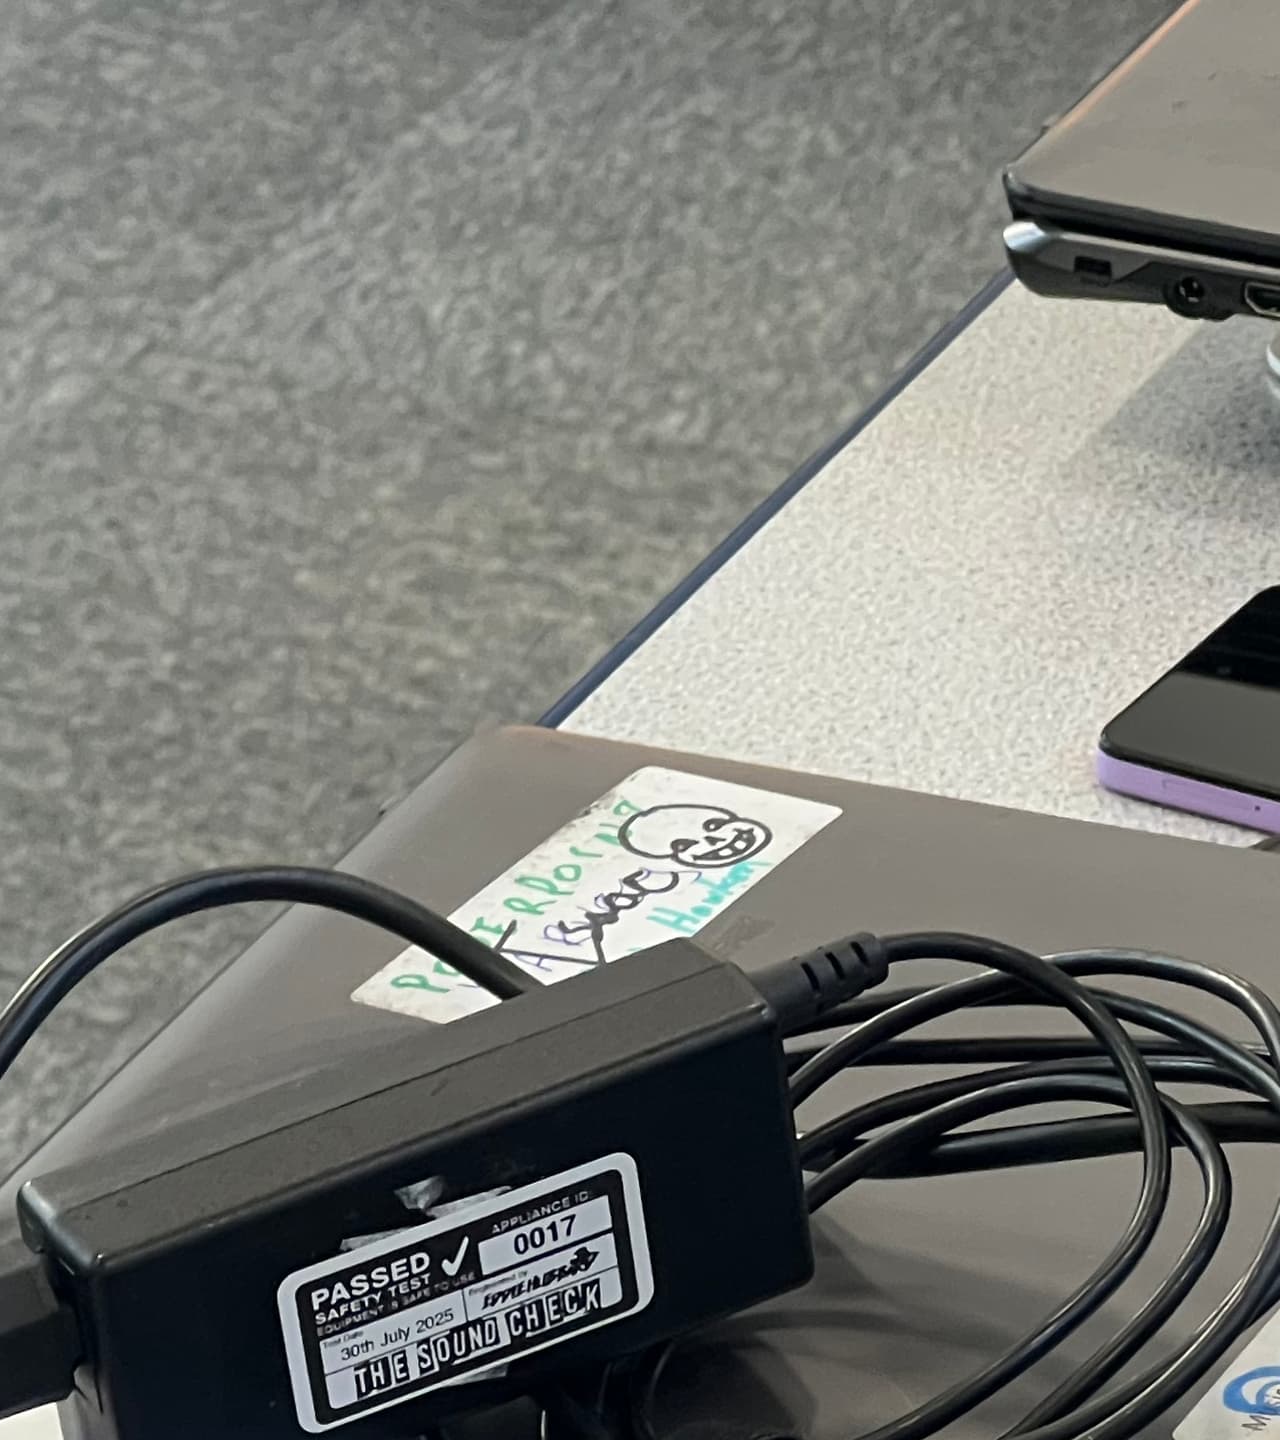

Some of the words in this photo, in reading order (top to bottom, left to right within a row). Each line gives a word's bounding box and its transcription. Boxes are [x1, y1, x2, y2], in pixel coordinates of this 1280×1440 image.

[492, 1196, 570, 1233] APPLIANCE
[574, 1191, 590, 1204] ID
[513, 1213, 577, 1255] 0017
[311, 1252, 430, 1310] PASSED
[315, 1290, 382, 1325] SAFETY
[388, 1273, 431, 1298] TEST
[434, 1280, 450, 1292] TO
[453, 1271, 476, 1288] USE
[341, 1338, 376, 1362] 30th
[380, 1325, 411, 1347] July
[415, 1307, 456, 1334] 2025
[354, 1352, 409, 1394] THE
[417, 1319, 498, 1370] SOUND
[508, 1283, 600, 1337] CHECK
